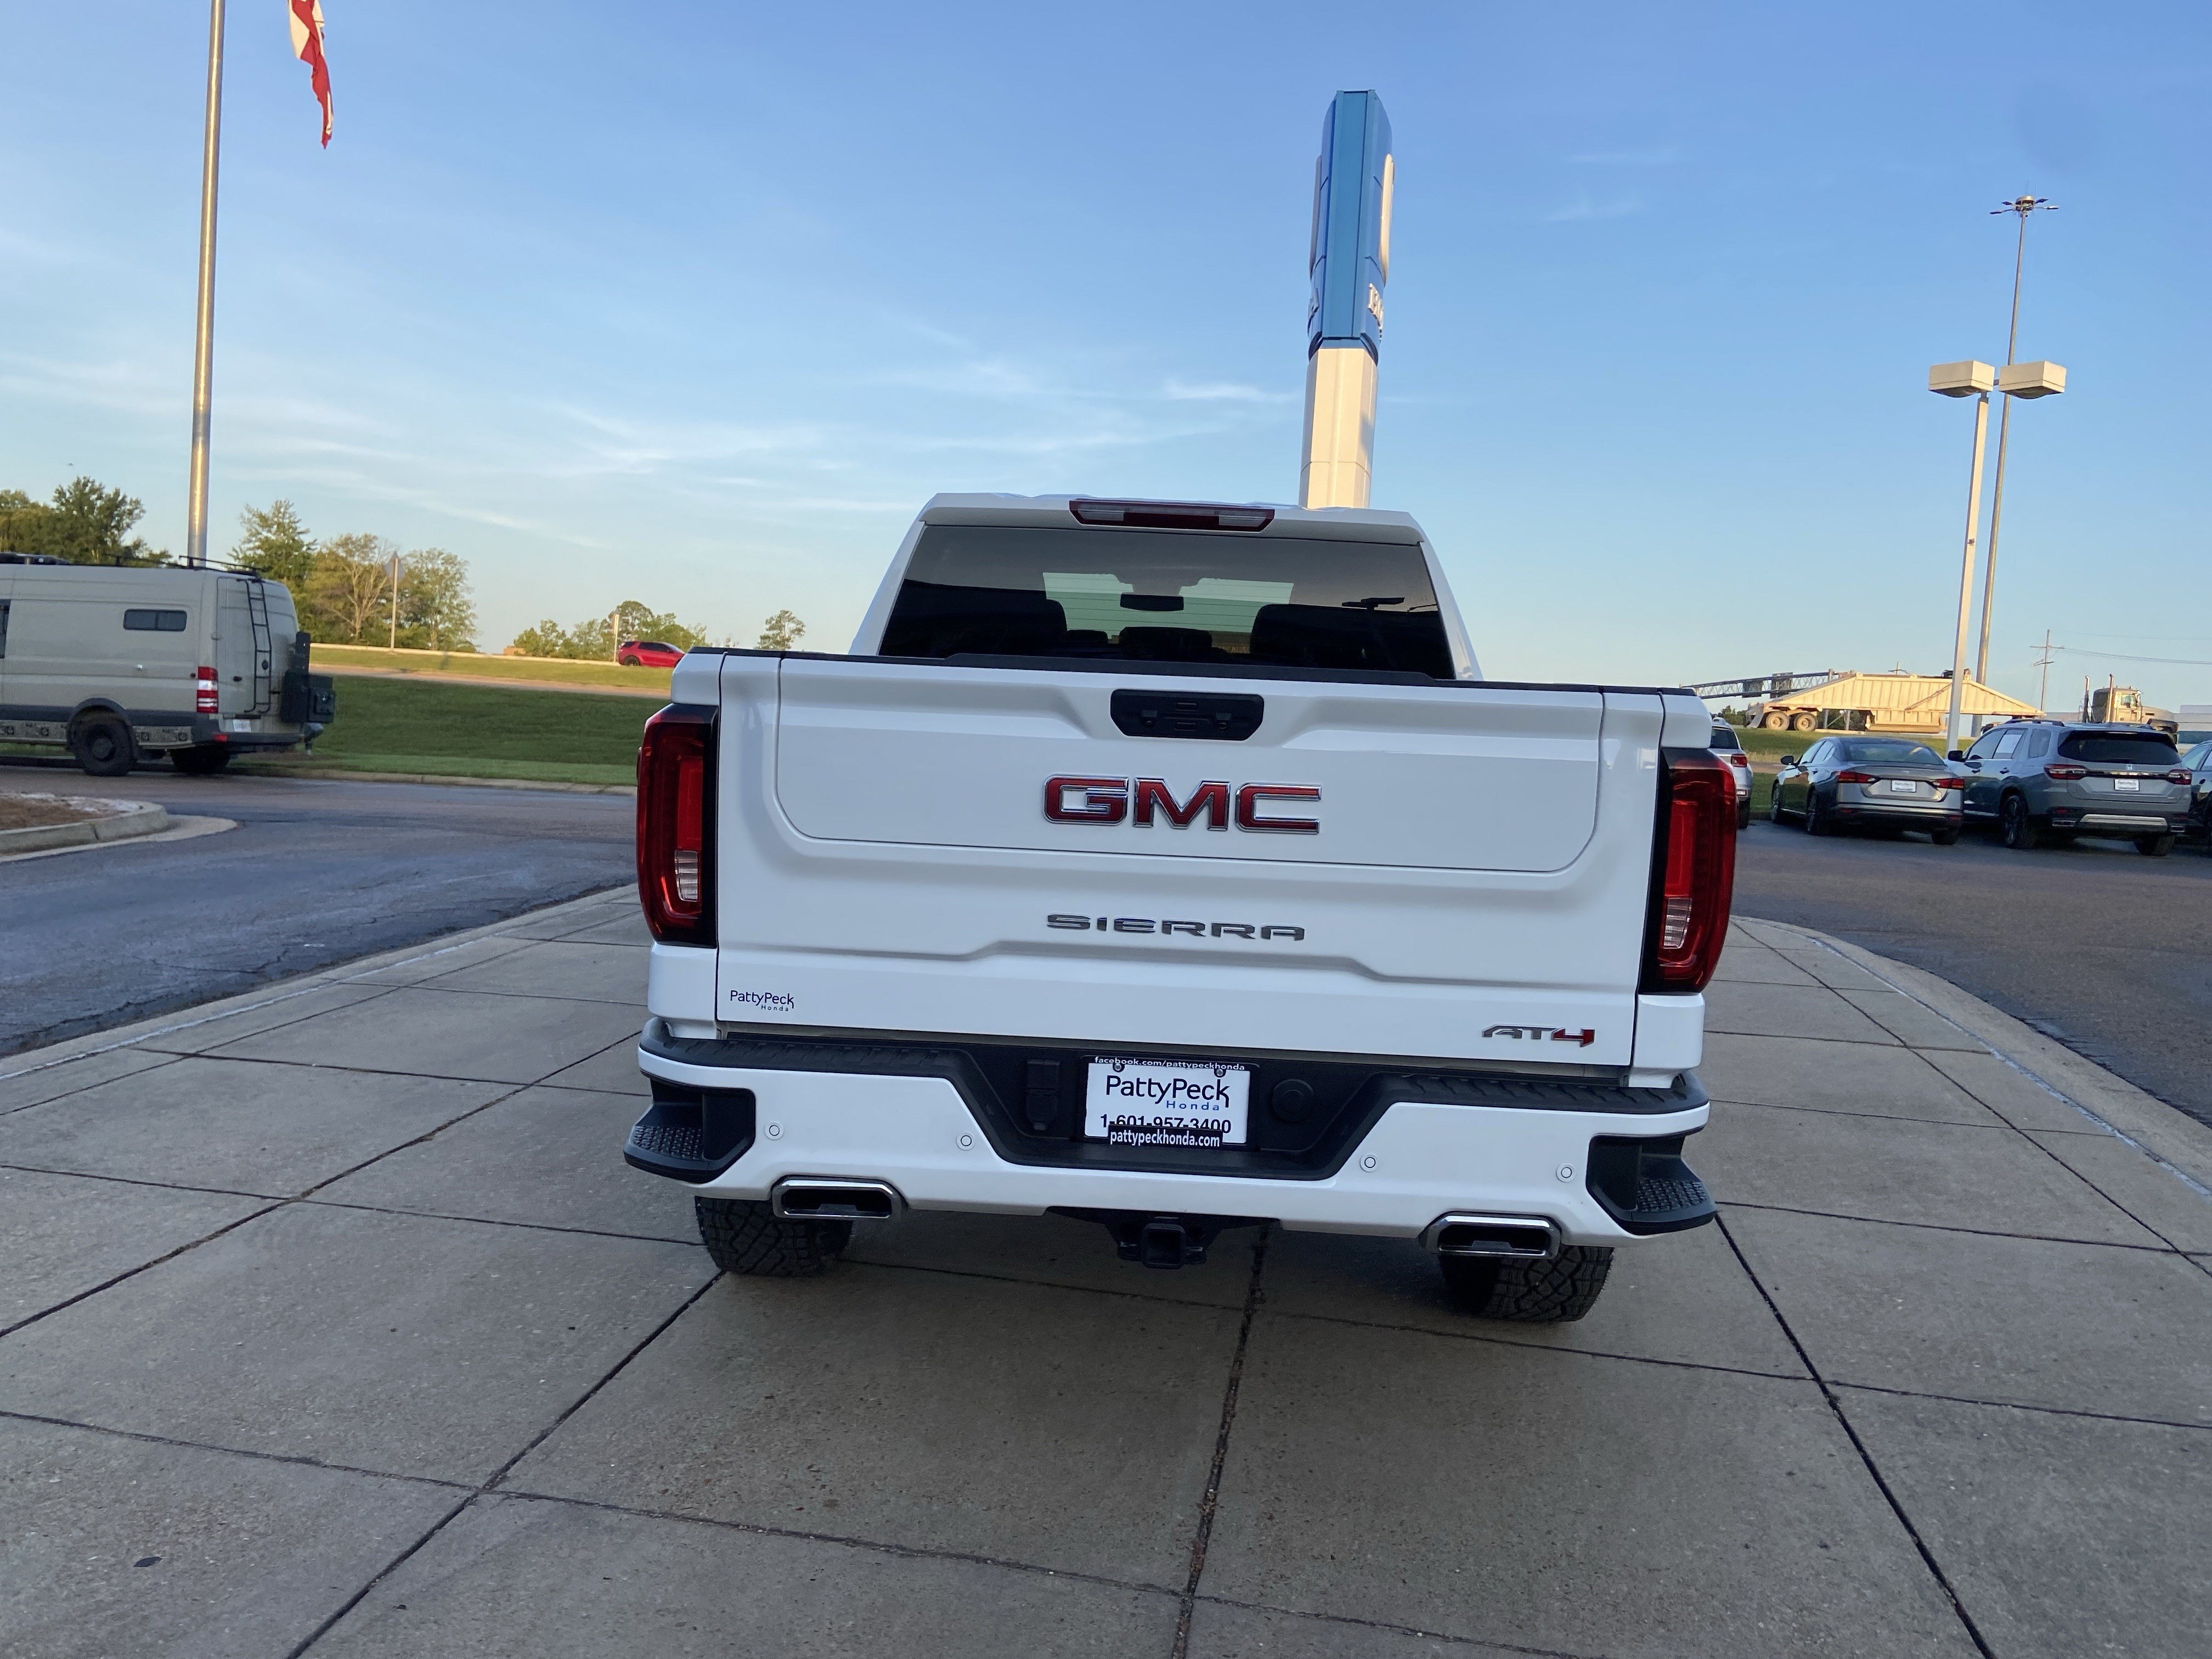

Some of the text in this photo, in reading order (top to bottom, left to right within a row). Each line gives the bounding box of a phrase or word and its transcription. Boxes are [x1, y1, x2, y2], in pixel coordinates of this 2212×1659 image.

[1043, 774, 1322, 834] GMC
[1047, 913, 1305, 941] SIERRA
[730, 990, 794, 1009] PattyPeck
[1482, 1023, 1595, 1047] AT4
[1094, 1056, 1245, 1070] facebook.com/pattypeckhonda
[1106, 1075, 1231, 1108] PattyPeck
[1166, 1101, 1220, 1111] Honda
[1100, 1114, 1231, 1133] 1-601-957-3400
[1110, 1128, 1220, 1147] pattypeckhonda.com
